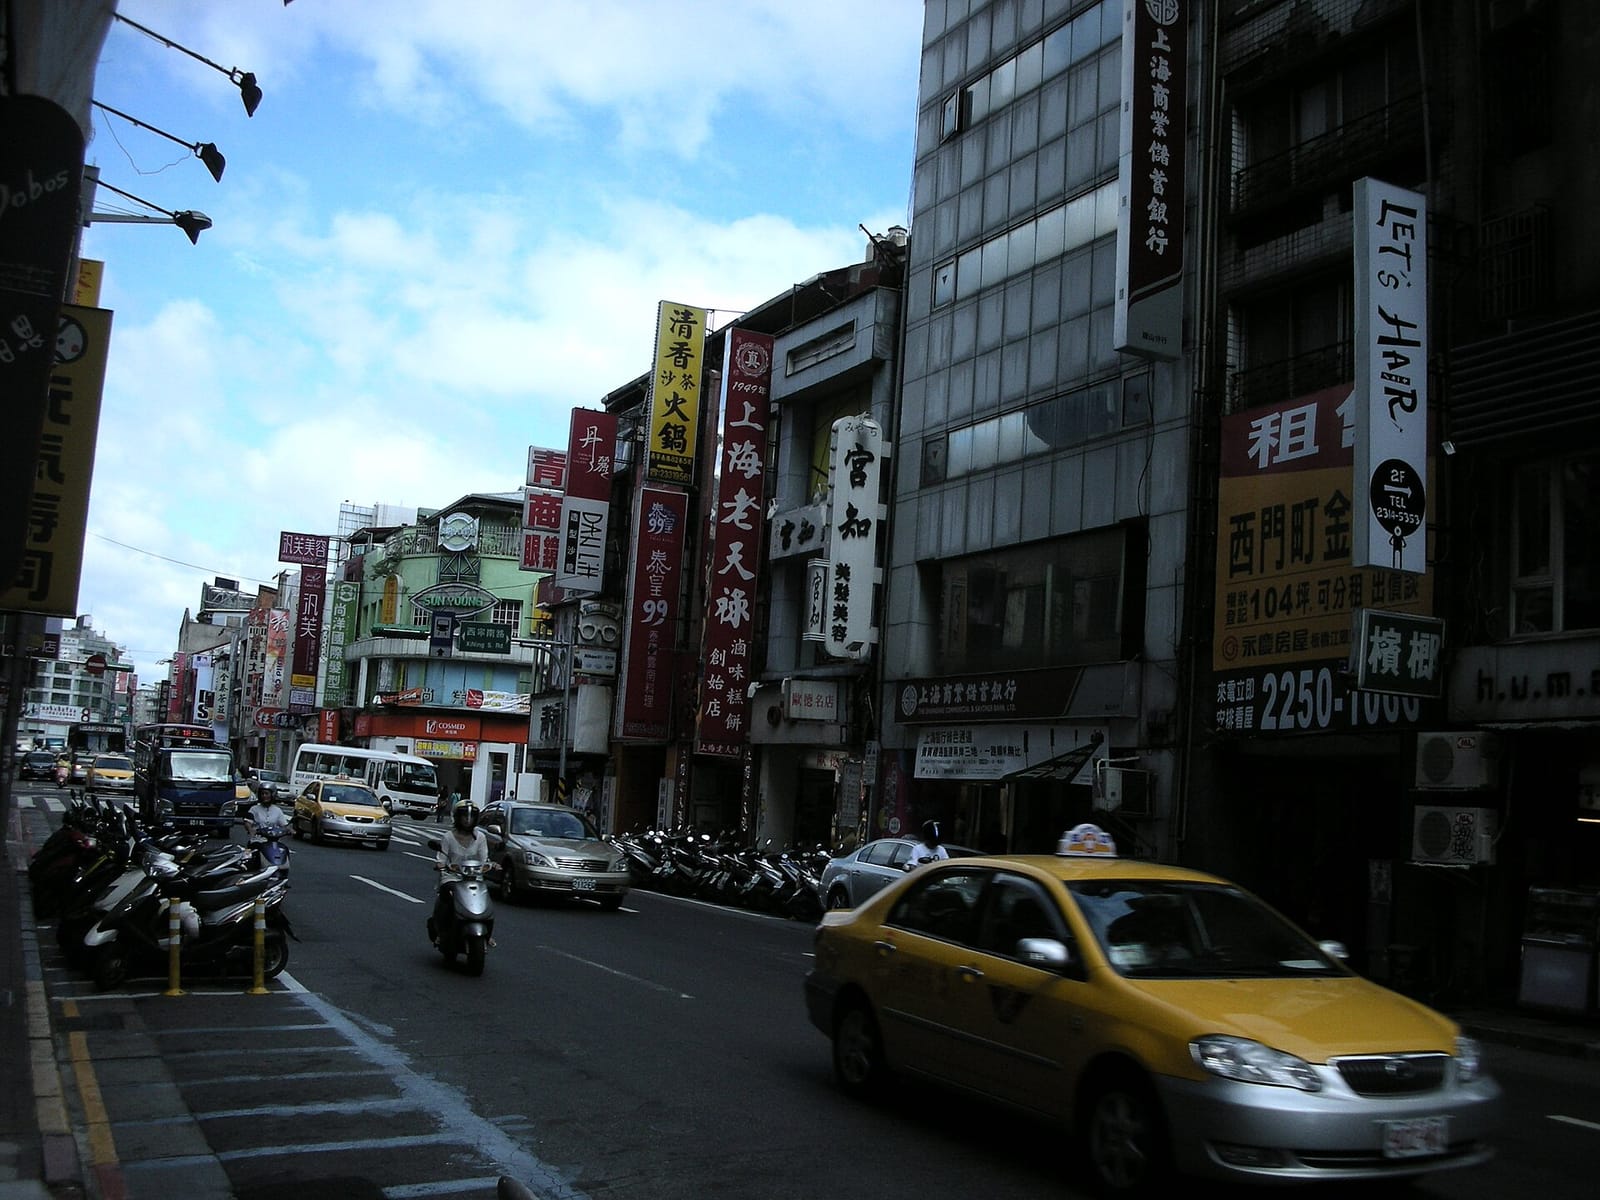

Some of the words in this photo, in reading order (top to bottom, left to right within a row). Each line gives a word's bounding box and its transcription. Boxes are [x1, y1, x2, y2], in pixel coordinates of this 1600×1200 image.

[1144, 28, 1171, 256] 上海商業儲蓄銀行
[1376, 199, 1418, 290] LET'S
[664, 309, 698, 370] 清香
[1377, 305, 1421, 423] HAIR
[661, 370, 696, 391] 沙茶
[732, 380, 768, 396] 1949年
[658, 391, 691, 455] 火鍋
[838, 442, 875, 540] 宮知
[1389, 495, 1407, 508] TEL
[1390, 468, 1406, 483] 2F
[714, 400, 765, 629] 上海老天祿
[1376, 506, 1420, 526] 2314-5353
[831, 562, 851, 642] 美髮美容
[1241, 628, 1310, 658] 永慶房屋
[1367, 625, 1441, 681] 檳榔
[705, 648, 726, 718] 創始店
[724, 638, 748, 732] 滷味糕餅
[438, 721, 466, 730] COSMED
